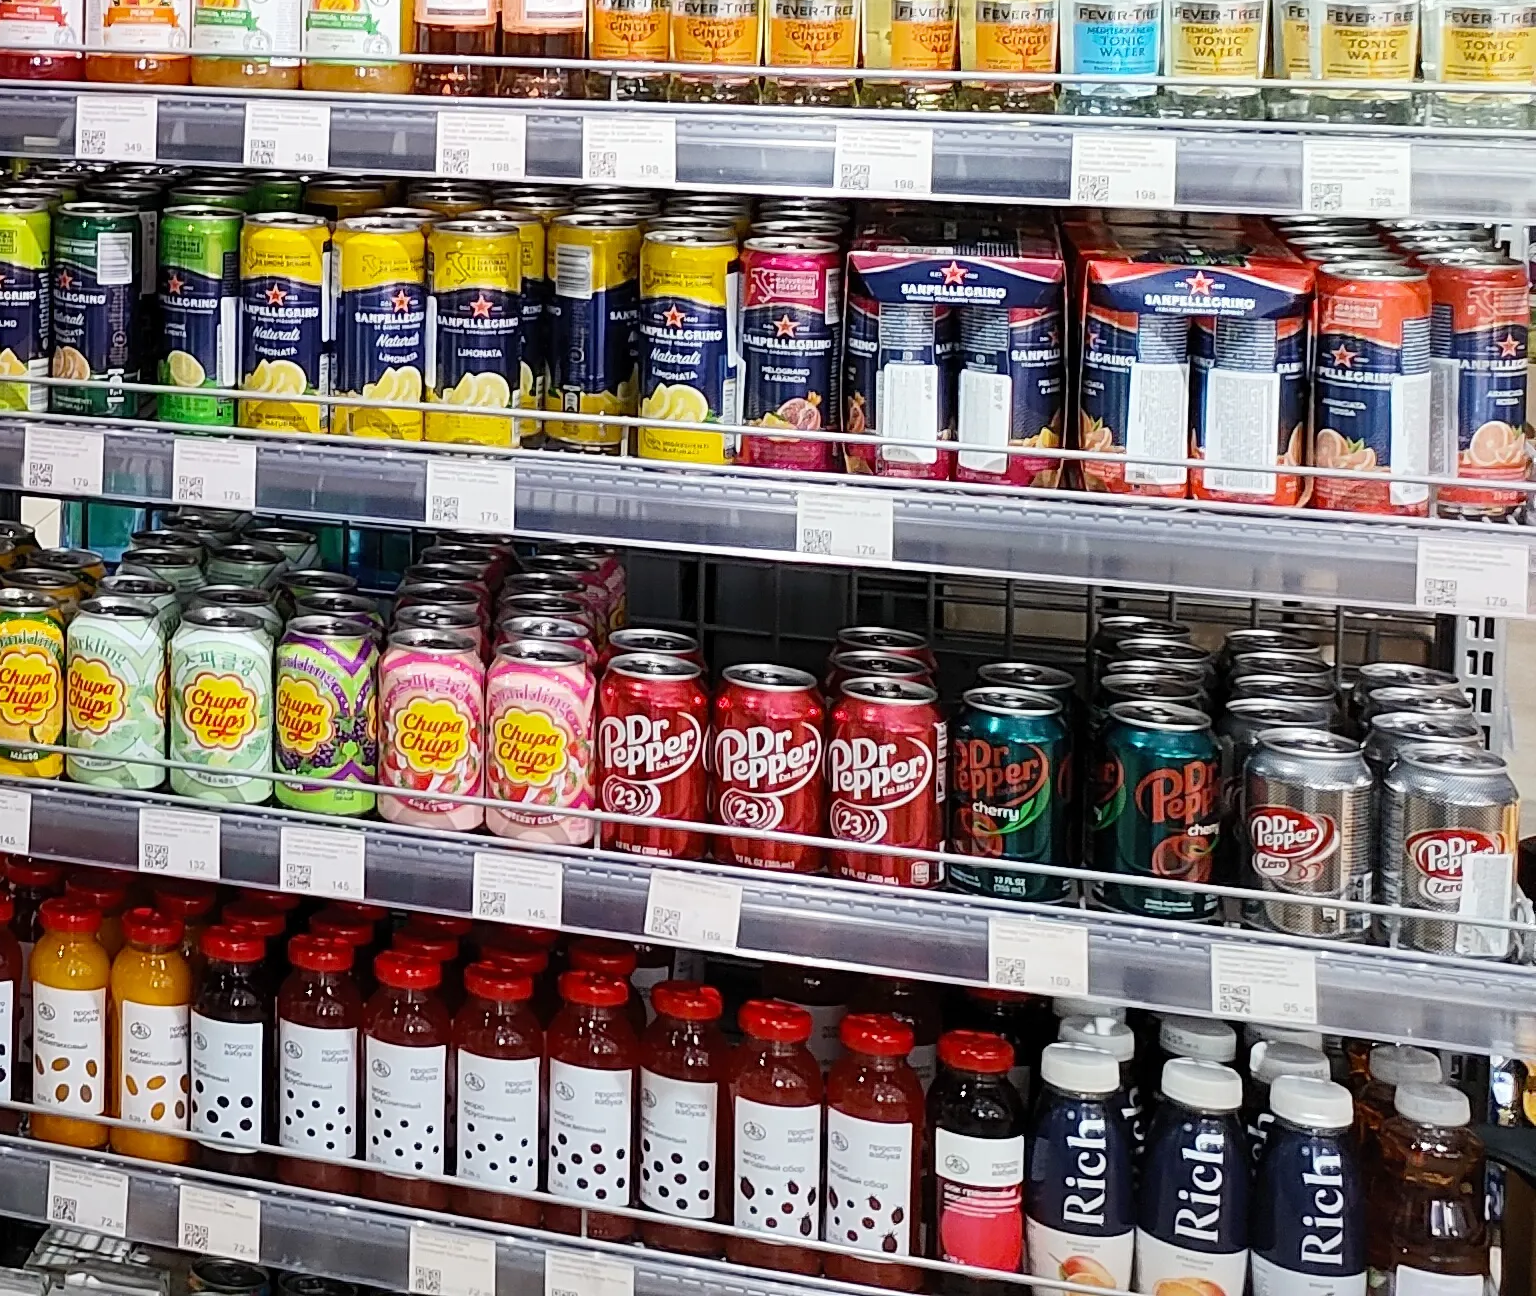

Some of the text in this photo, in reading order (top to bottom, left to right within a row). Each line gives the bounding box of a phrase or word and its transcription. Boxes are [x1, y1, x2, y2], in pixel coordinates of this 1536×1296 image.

[677, 1, 757, 16] FEVER-TREE
[776, 3, 854, 17] FEVER-TREE
[899, 5, 954, 18] FEVER-T
[983, 6, 1055, 22] FEVER-TR
[1172, 6, 1260, 21] FEVER-TREE
[1327, 9, 1414, 24] FEVER-TREE
[1444, 10, 1536, 25] FEVER-TREE
[610, 22, 656, 32] GINGER
[693, 28, 739, 40] GINGER
[791, 30, 840, 42] GINGER
[1001, 34, 1048, 45] GINGE
[1100, 35, 1145, 46] TONIC
[1194, 35, 1240, 46] TONIC
[1348, 38, 1398, 49] TONIC
[1100, 46, 1146, 58] WATER
[1193, 46, 1244, 58] WATER
[1464, 40, 1513, 51] TONIC
[1348, 50, 1398, 60] WATER
[1464, 51, 1515, 62] WATER
[1134, 190, 1156, 200] 198
[901, 283, 1006, 298] SANPELLEGRINO
[1145, 293, 1256, 310] SANPELLEGRINO
[355, 311, 424, 324] SANPELLEGR
[458, 347, 502, 358] LIMONATA
[1318, 368, 1401, 384] PELLEGRINO
[70, 669, 116, 697] Chupa
[68, 689, 113, 721] Chups
[191, 688, 249, 710] Chupa
[280, 689, 324, 717] Chupa
[189, 707, 246, 739] Chups
[278, 708, 322, 744] Chups
[403, 712, 464, 735] Chupa
[626, 714, 669, 748] Dr
[501, 722, 561, 746] Chupa
[400, 731, 460, 764] Chups
[599, 716, 694, 775] Pepper
[746, 726, 793, 761] Dr
[499, 741, 557, 776] Chups
[715, 728, 816, 788] Pepper
[852, 737, 897, 770] Dr
[969, 739, 1009, 770] Dr
[829, 739, 924, 800] Pepper
[614, 785, 637, 810] 23
[734, 798, 760, 823] 23
[972, 801, 1020, 822] cherry
[840, 811, 862, 836] 23
[1273, 814, 1301, 831] Dr
[0, 835, 16, 845] 145
[1252, 816, 1317, 851] Pepper
[1449, 837, 1477, 856] Dr
[188, 860, 206, 870] 132
[1260, 856, 1287, 869] Zero
[331, 880, 350, 891] 145
[527, 908, 546, 919] 145
[1062, 1118, 1108, 1228] Rich
[1174, 1130, 1226, 1245] Rich
[1301, 1149, 1345, 1267] Rich
